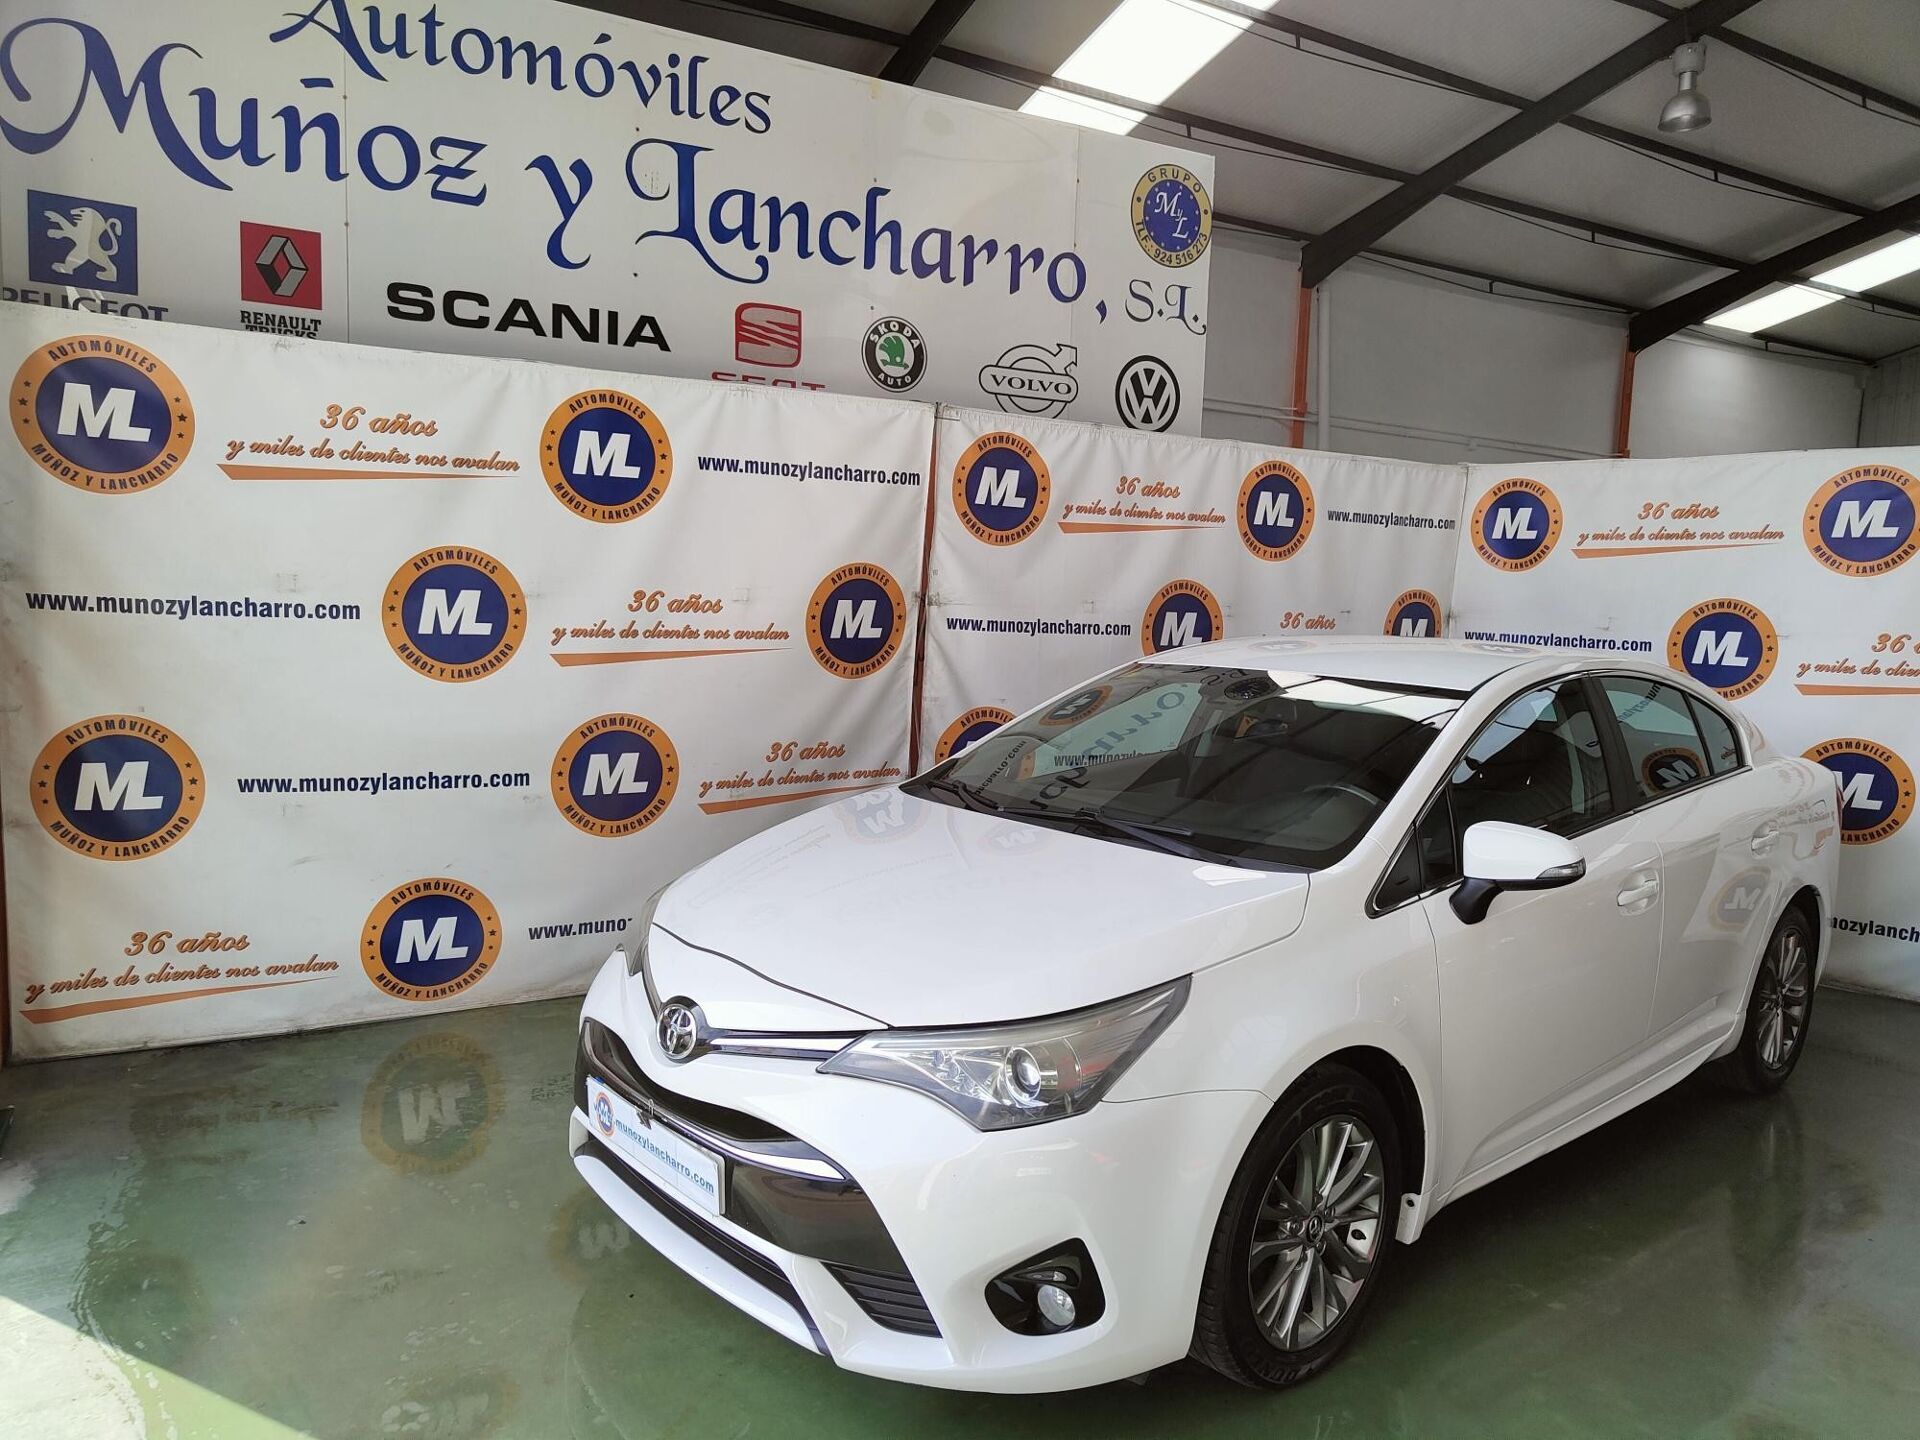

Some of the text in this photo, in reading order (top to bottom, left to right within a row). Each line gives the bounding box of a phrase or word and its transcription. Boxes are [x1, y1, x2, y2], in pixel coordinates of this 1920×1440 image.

[270, 0, 772, 134] Automóviles
[0, 17, 488, 207] Muñoz
[525, 154, 594, 270] y
[625, 137, 1108, 325] Lancharro,
[1147, 167, 1201, 194] GRUPO
[1153, 249, 1173, 266] 924
[1175, 252, 1194, 265] 516
[1192, 232, 1208, 256] 273
[240, 310, 321, 333] RENAULT
[386, 281, 671, 352] SCANIA
[870, 320, 921, 349] SKODA
[48, 340, 157, 374] AUTOMÓVILES
[877, 372, 912, 386] AUTO
[990, 373, 1072, 396] VOLVO
[57, 382, 152, 443] ML
[319, 403, 438, 437] 36 años
[568, 393, 646, 420] AUTOMÓVILES
[225, 435, 520, 472] y miles de clientes nos avalan
[572, 429, 641, 479] ML
[977, 434, 1032, 458] AUTOMÓVILES
[31, 443, 179, 491] MUÑOZ Y LANCHARRO
[698, 456, 921, 486] www.munozylancharro.com
[974, 466, 1027, 509] ML
[1116, 475, 1181, 498] 36 años
[553, 482, 661, 520] MUÑOZ Y LANCHARRO
[1062, 499, 1226, 523] y miles de clientes nos avalan
[1253, 490, 1295, 528] ML
[1637, 502, 1720, 520] 36 años
[987, 533, 993, 541] Y
[995, 515, 1040, 543] LANCHARRO
[1328, 509, 1456, 531] www.munozylancharro.com
[1491, 507, 1539, 540] ML
[1831, 499, 1899, 538] ML
[1576, 523, 1785, 547] y miles de clientes nos avalan
[413, 548, 499, 576] AUTOMÓVILES
[830, 565, 890, 587] AUTOMÓVILES
[1846, 565, 1852, 573] Y
[627, 589, 724, 614] 36 años
[1161, 581, 1208, 601] AUTOMÓVILES
[26, 592, 361, 621] www.munozylancharro.com
[418, 588, 493, 636] ML
[830, 599, 883, 639] ML
[1692, 600, 1758, 620] AUTOMÓVILES
[551, 619, 790, 646] y miles de clientes nos avalan
[947, 615, 1132, 639] www.munozylancharro.com
[1280, 611, 1337, 631] 36 años
[1465, 631, 1652, 652] www.munozylancharro.com
[1691, 629, 1749, 667] ML
[1871, 632, 1912, 653] 36
[397, 643, 514, 679] MUÑOZ Y LANCHARRO
[842, 666, 849, 675] Y
[851, 644, 896, 676] LANCHARRO
[1796, 662, 1812, 678] y
[1814, 658, 1857, 674] miles
[1860, 659, 1881, 675] de
[65, 718, 169, 745] AUTOMÓVILES
[580, 716, 655, 739] AUTOMÓVILES
[960, 708, 1014, 729] AUTOMÓVIL
[765, 741, 846, 763] 36 años
[1815, 741, 1893, 763] AUTOMÓVILES
[74, 760, 164, 811] ML
[237, 771, 531, 796] www.munozylancharro.com
[582, 752, 649, 796] ML
[699, 759, 901, 798] y miles de clientes nos avalan
[563, 798, 667, 834] MUÑOZ Y LANCHARRO
[1841, 818, 1900, 842] LANCHARRO
[50, 815, 190, 857] MUÑOZ Y LANCHARRO
[391, 880, 475, 905] AUTOMÓVILES
[124, 931, 250, 956] 36 años
[395, 916, 469, 964] ML
[24, 953, 339, 1004] y miles de clientes nos avalan
[375, 961, 488, 998] MUÑOZ Y LANCHARRO
